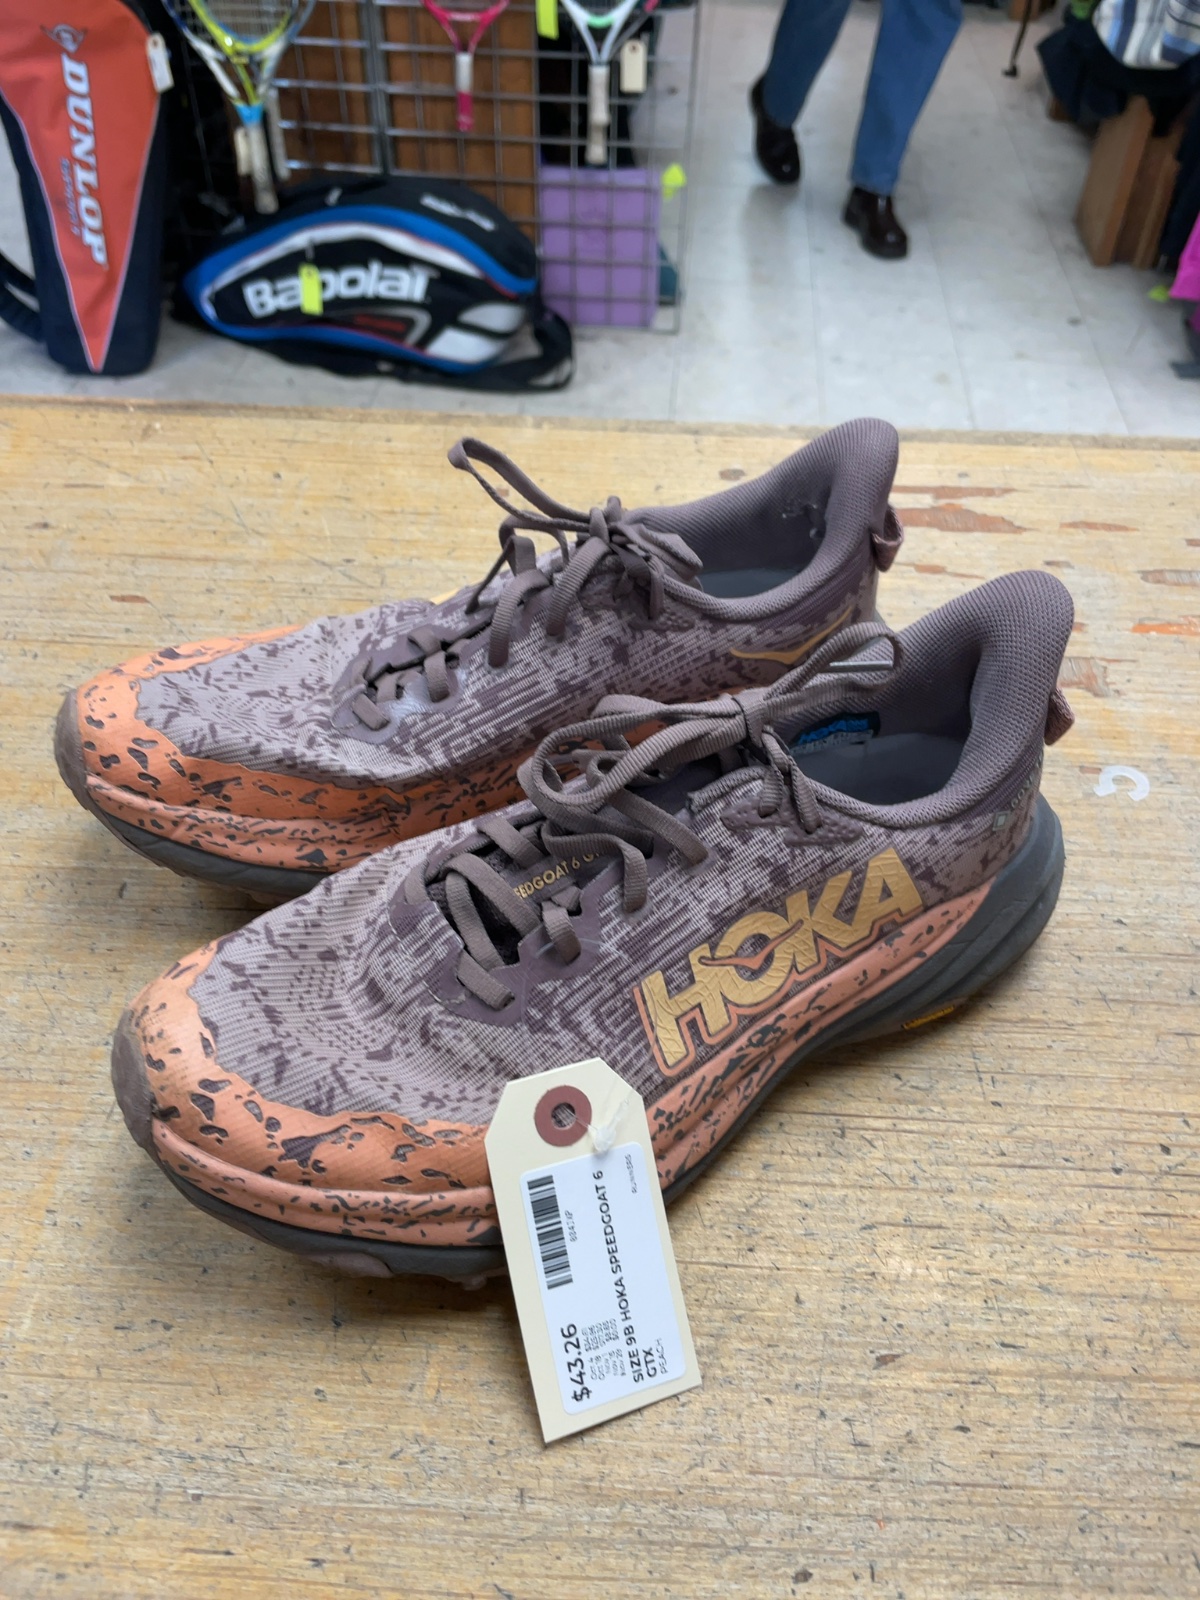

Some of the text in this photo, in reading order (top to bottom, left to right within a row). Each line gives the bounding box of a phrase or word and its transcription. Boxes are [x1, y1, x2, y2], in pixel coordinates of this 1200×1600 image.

[61, 53, 109, 269] DUNLOP
[572, 856, 580, 869] 6
[634, 847, 924, 1076] HOKA
[593, 1170, 644, 1383] SIZE 9B HOKA SPEEDGOAT 6
[561, 1323, 592, 1402] $43.26
[642, 1347, 658, 1378] GTX
[654, 1338, 668, 1374] PEACH
